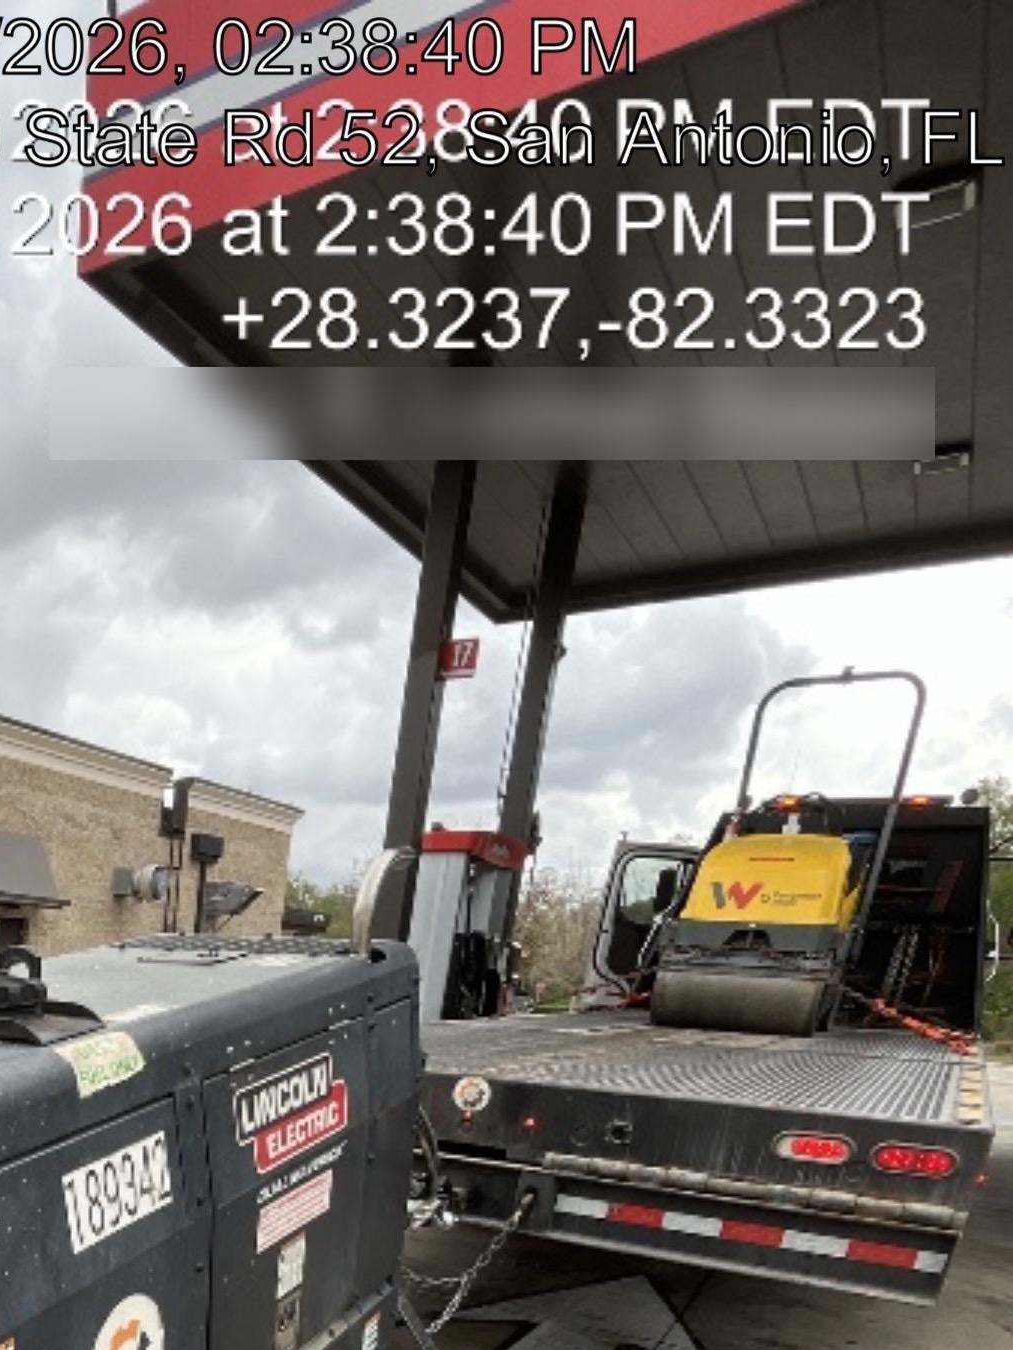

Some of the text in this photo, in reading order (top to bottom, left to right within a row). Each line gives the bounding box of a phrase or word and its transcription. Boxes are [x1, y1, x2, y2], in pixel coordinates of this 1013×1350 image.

[452, 641, 474, 667] 17
[241, 1061, 328, 1133] LINCOLN
[267, 1102, 338, 1159] ELECTRIC
[63, 1136, 173, 1245] 189342
